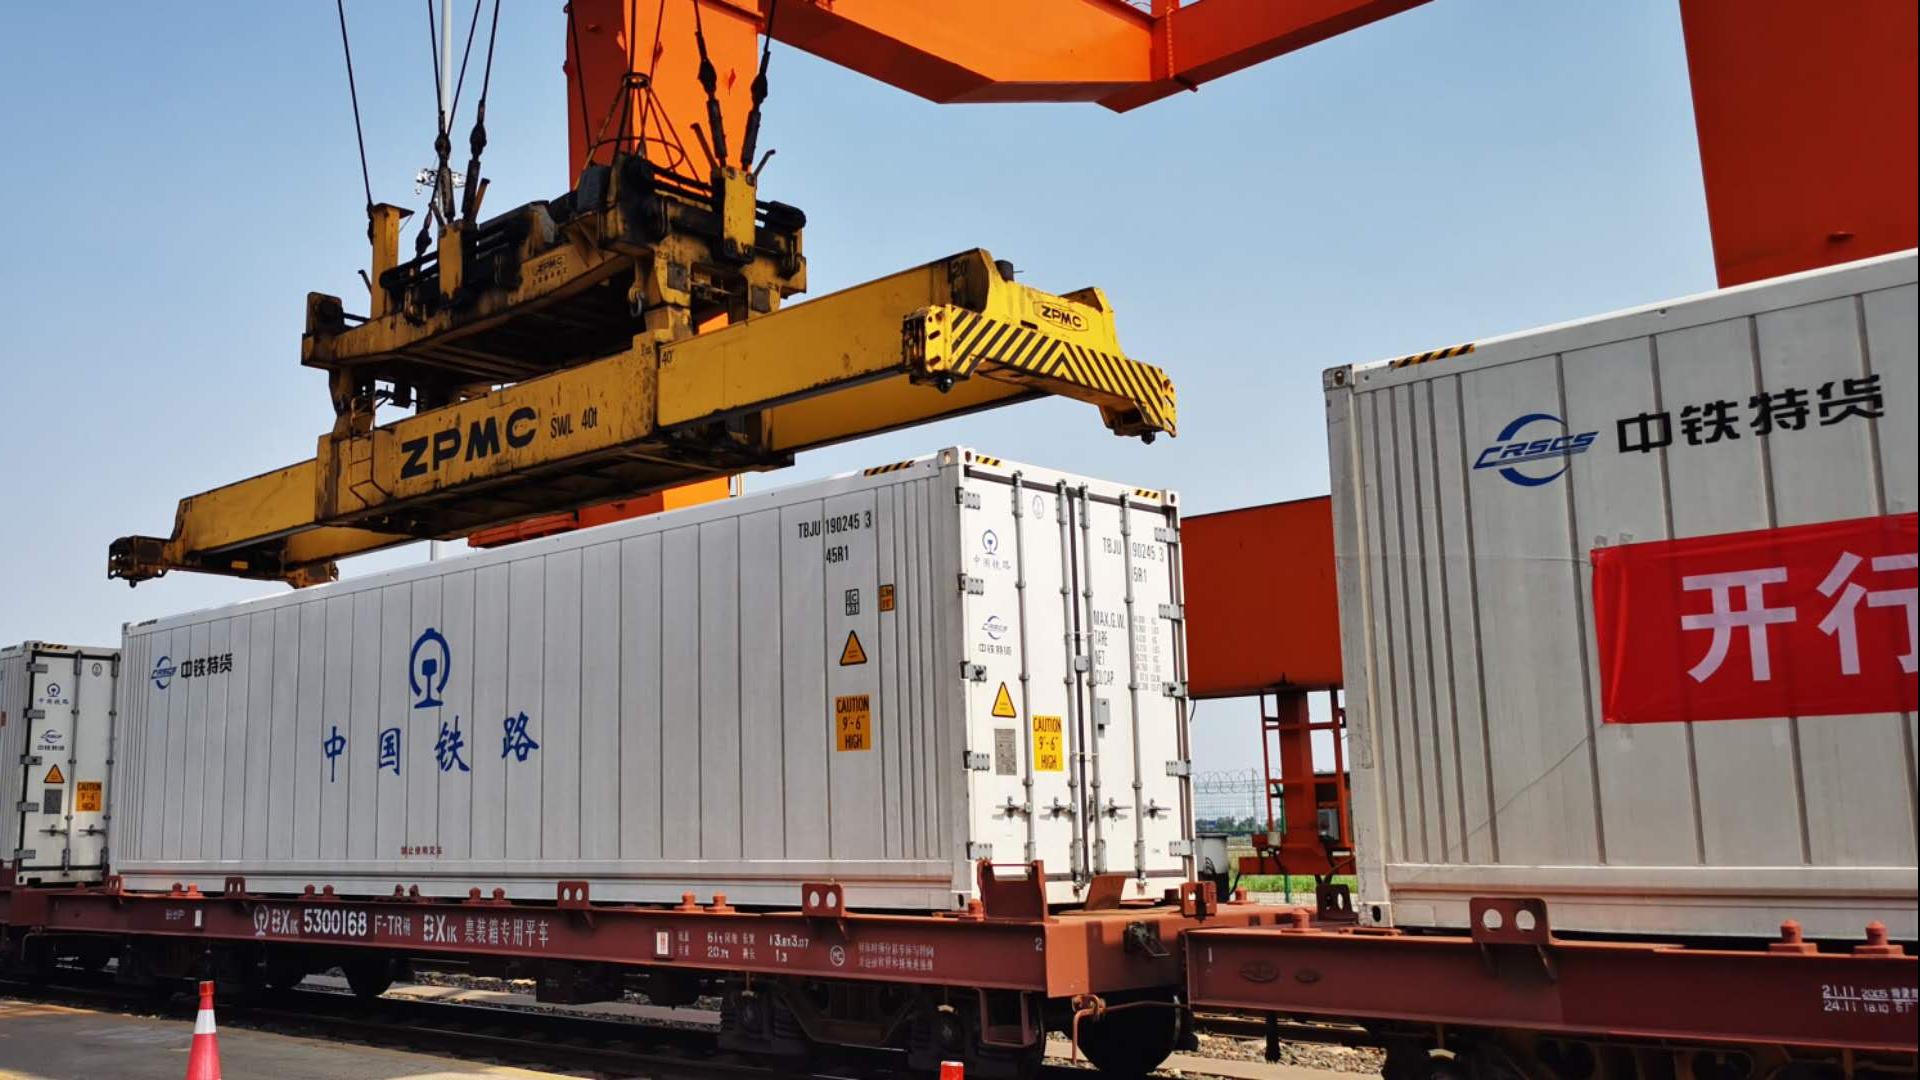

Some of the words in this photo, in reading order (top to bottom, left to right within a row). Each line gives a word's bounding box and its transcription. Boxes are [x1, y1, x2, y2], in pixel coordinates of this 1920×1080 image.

[1041, 304, 1083, 328] ZPMC
[1616, 374, 1885, 454] 中铁特货
[400, 406, 537, 480] ZPMC
[550, 414, 574, 439] SWL
[581, 406, 598, 430] 40t
[1472, 431, 1600, 470] CRSCS
[798, 520, 821, 538] TBJU
[825, 513, 860, 535] 190245
[864, 510, 872, 528] 3
[826, 545, 849, 563] 45R1
[1132, 541, 1156, 561] 90245
[1133, 566, 1148, 584] 5R1
[1681, 551, 1918, 684] 开行
[180, 653, 233, 679] 中铁特货
[836, 695, 870, 713] CAUTION
[1033, 716, 1062, 733] CAUTION
[323, 711, 539, 783] 中国铁路
[845, 733, 863, 750] HIGH
[1041, 754, 1058, 770] HIGH
[303, 908, 368, 937] 5300168
[464, 917, 549, 948] 集装箱专用平车
[1034, 937, 1043, 952] 2
